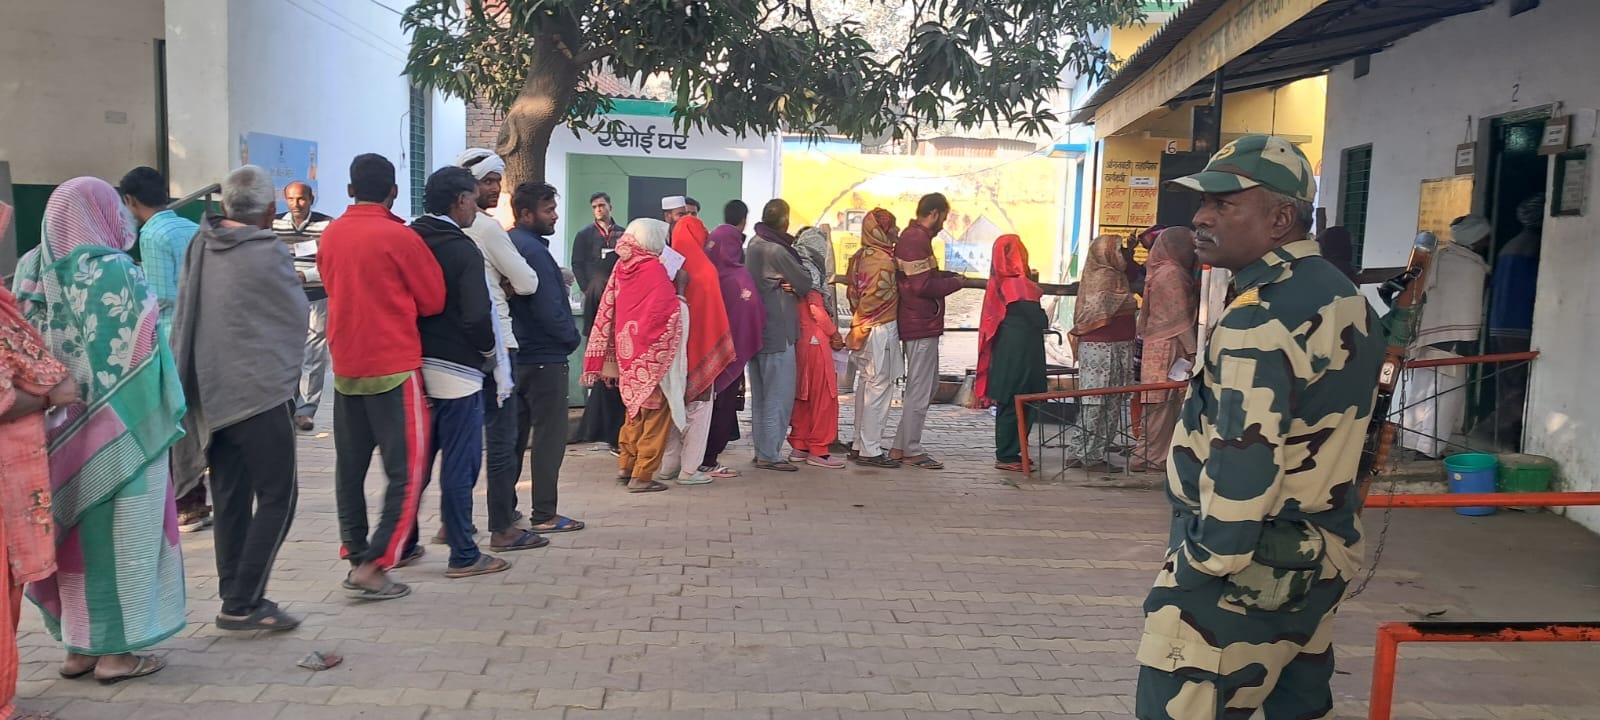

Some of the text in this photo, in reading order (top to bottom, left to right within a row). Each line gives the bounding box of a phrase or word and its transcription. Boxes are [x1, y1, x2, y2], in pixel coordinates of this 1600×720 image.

[1512, 83, 1520, 102] 2
[598, 125, 690, 154] रसोई घर
[1167, 141, 1177, 154] 6
